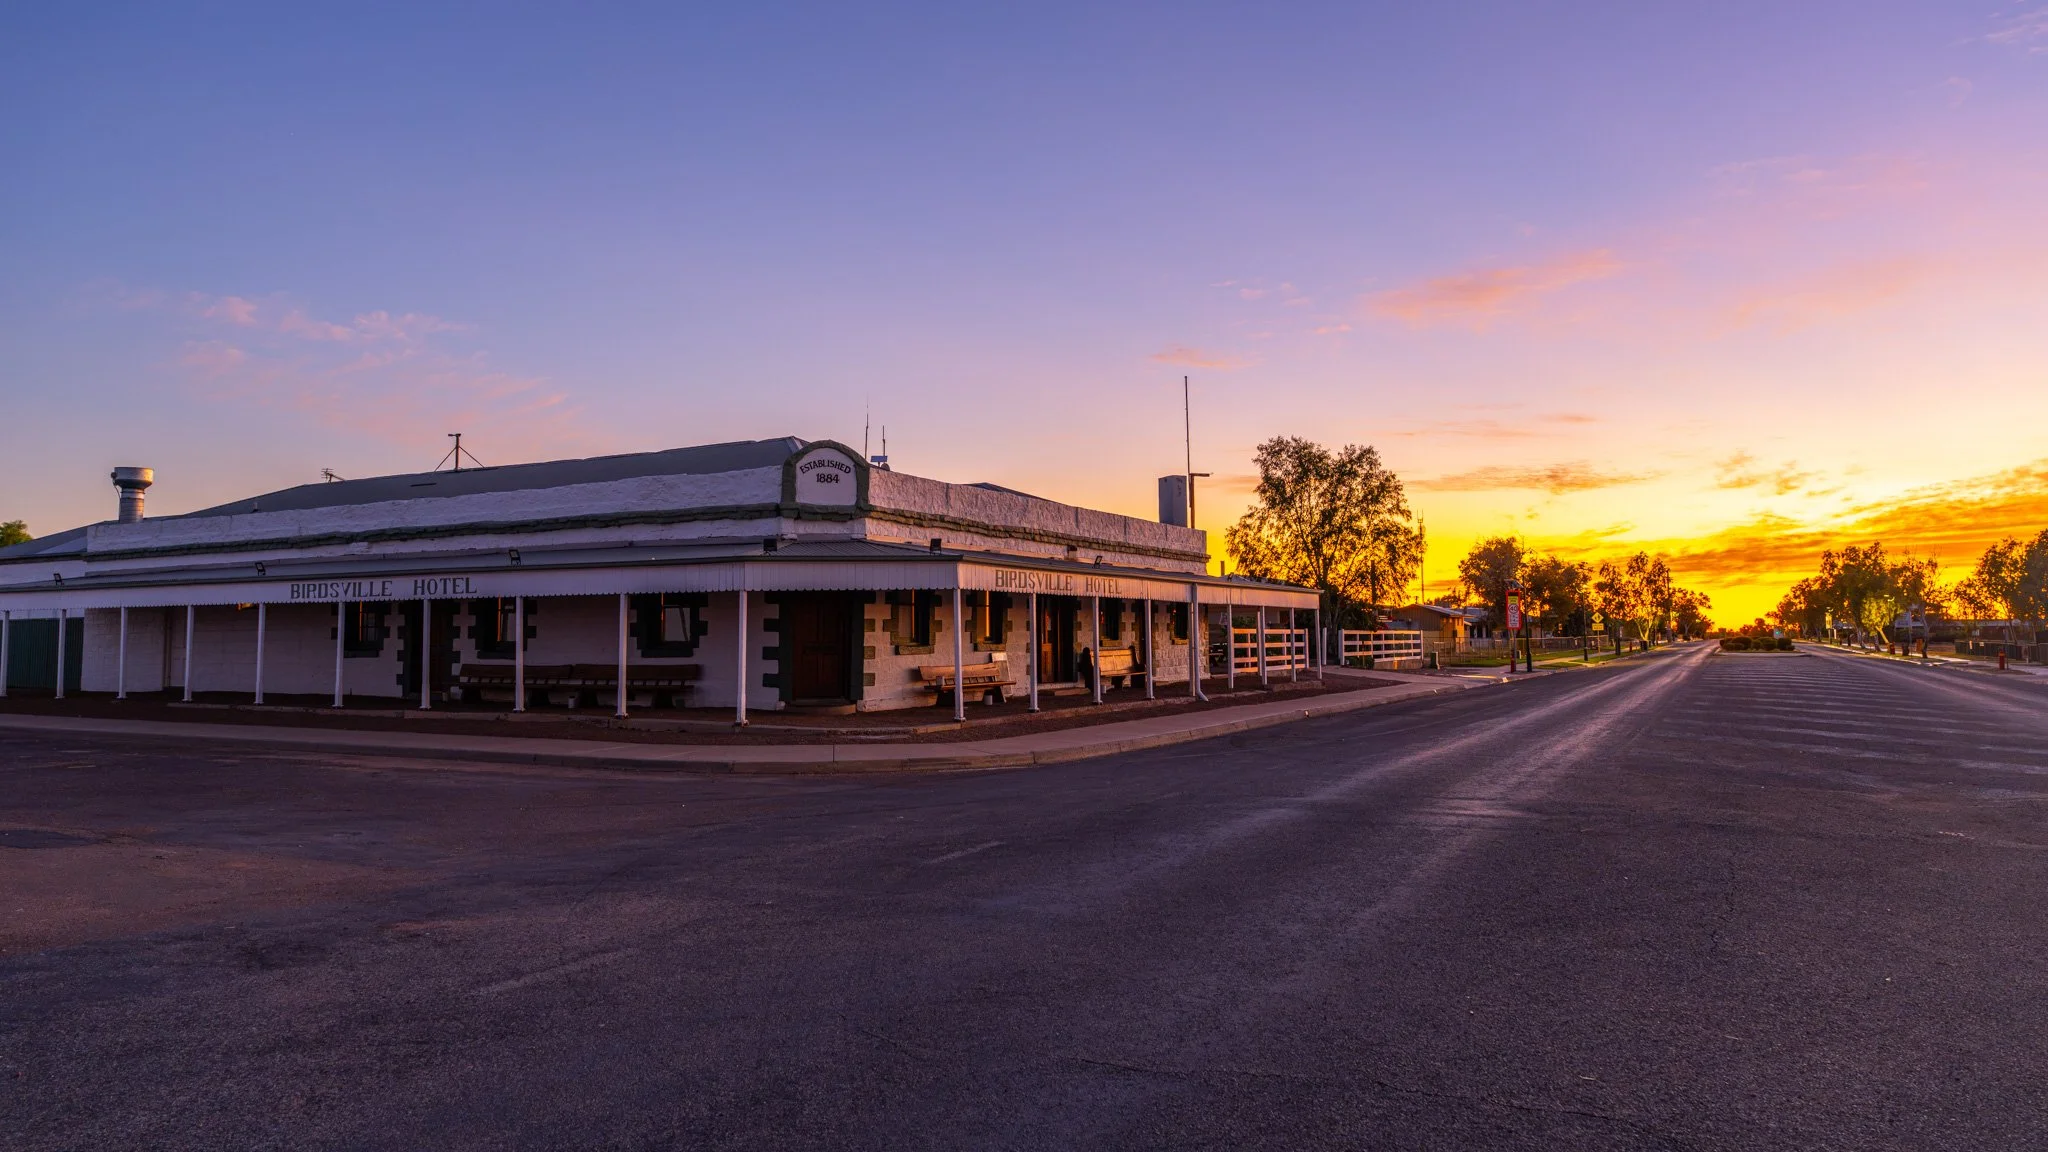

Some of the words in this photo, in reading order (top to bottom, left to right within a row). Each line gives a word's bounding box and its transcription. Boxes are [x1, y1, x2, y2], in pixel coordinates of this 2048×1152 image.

[800, 459, 851, 474] ESTABLISHED
[816, 473, 840, 484] 1884
[290, 580, 393, 600] BIRDSVILLE
[413, 577, 478, 596] HOTEL
[996, 569, 1073, 592] BIRDSVILLE
[1085, 576, 1122, 595] HOTEL
